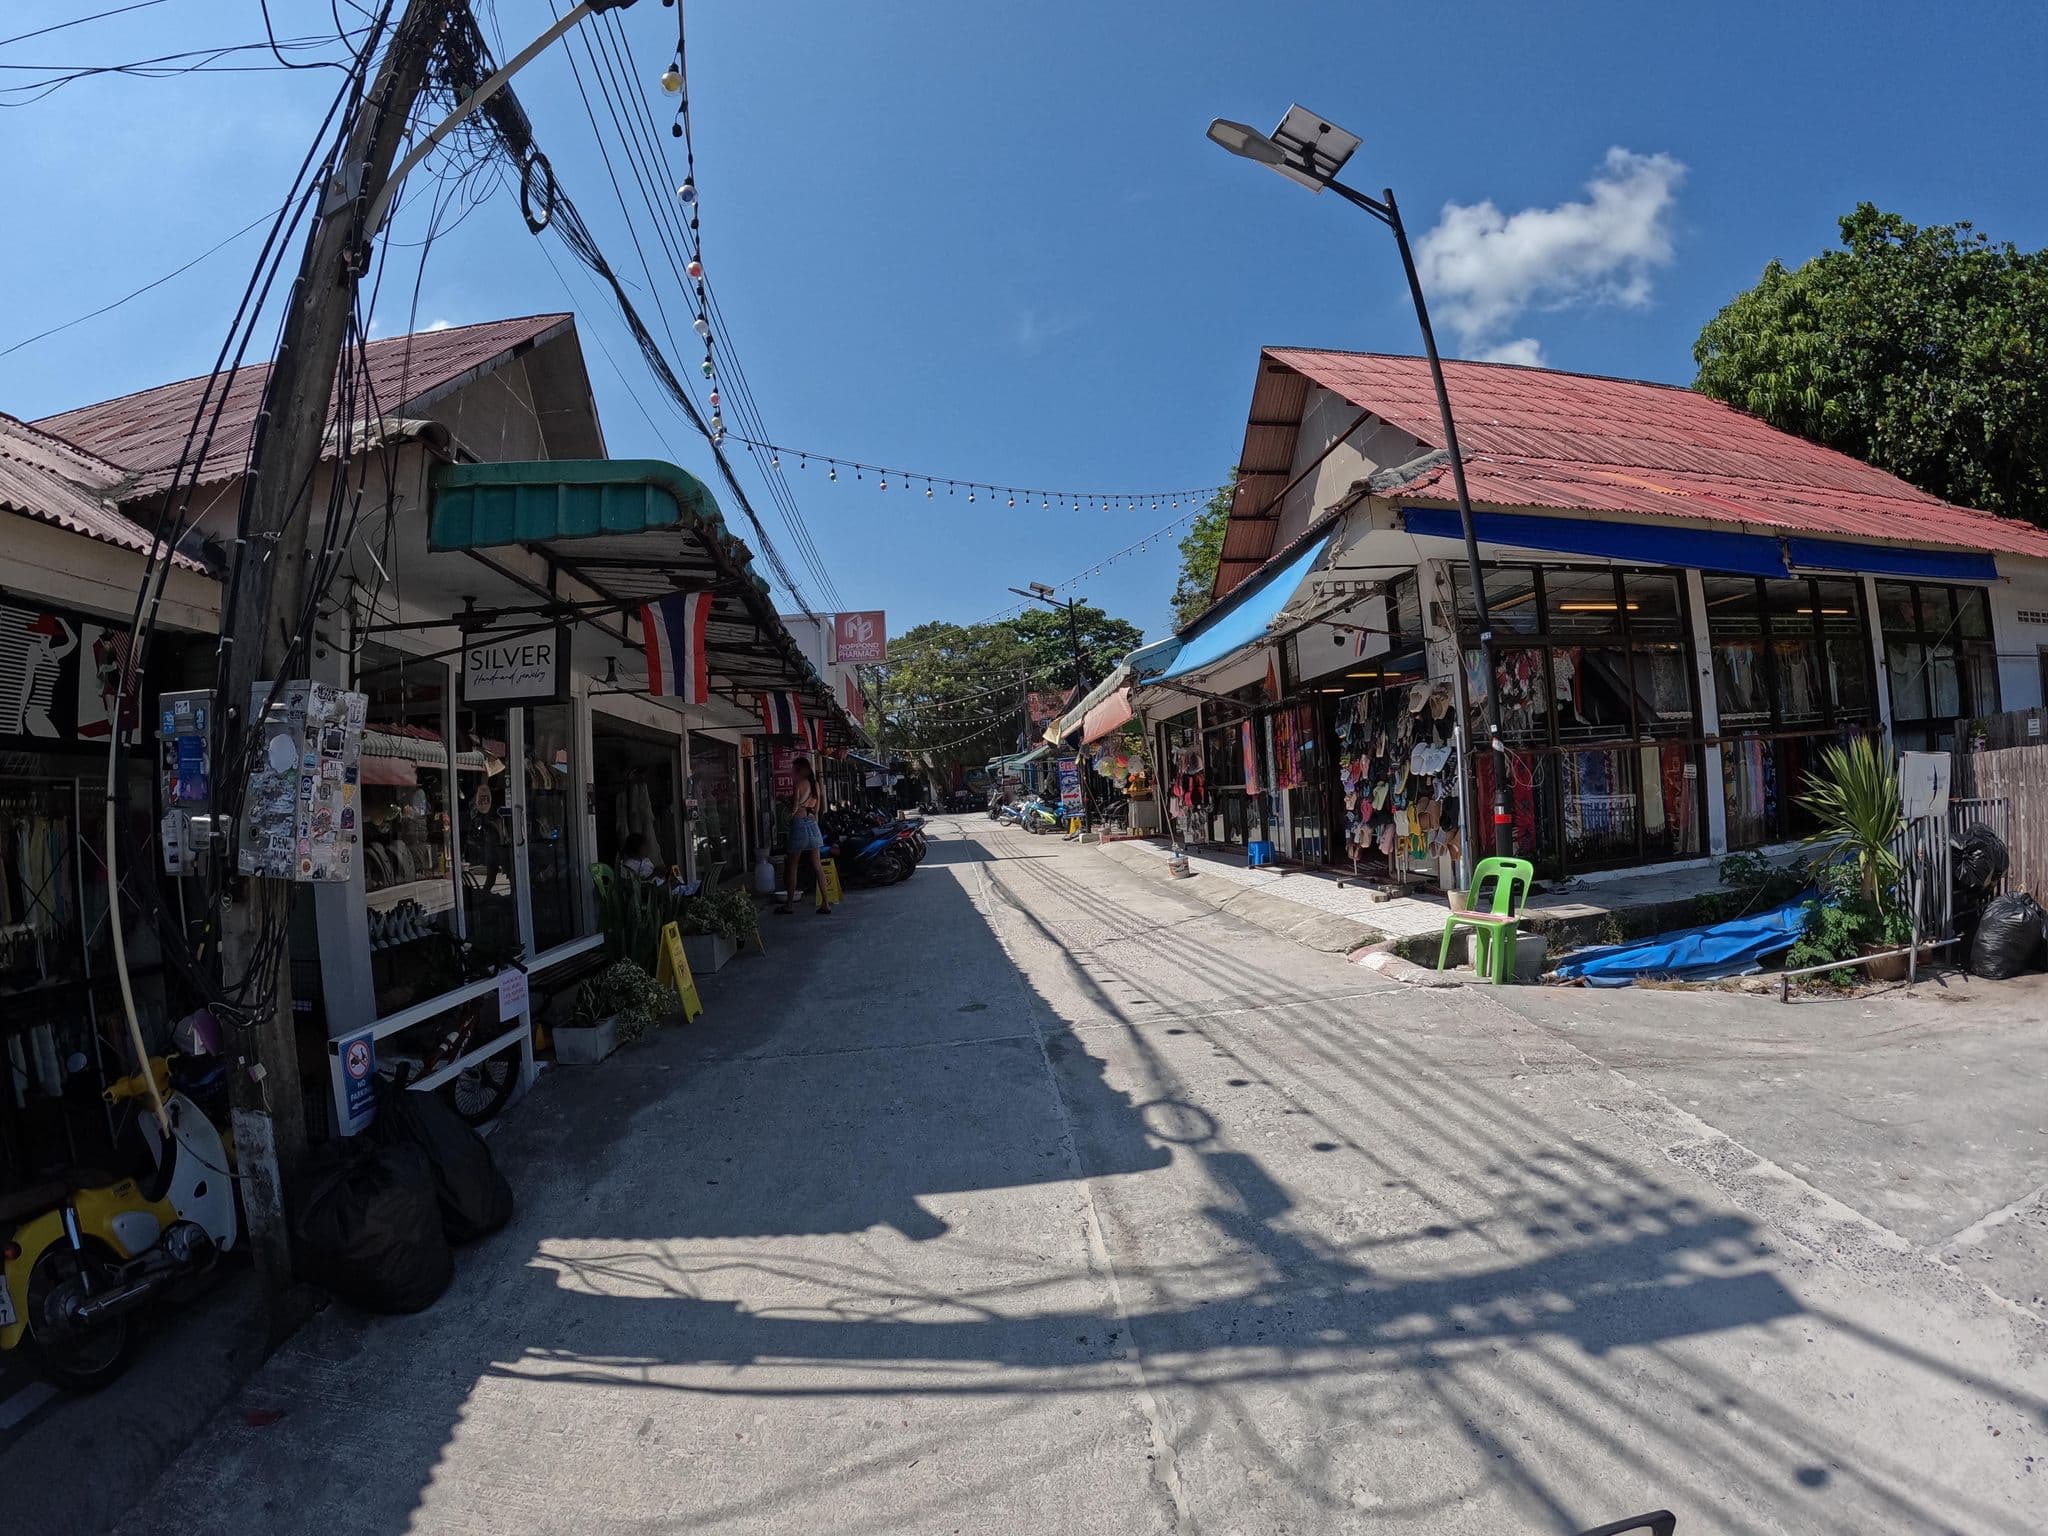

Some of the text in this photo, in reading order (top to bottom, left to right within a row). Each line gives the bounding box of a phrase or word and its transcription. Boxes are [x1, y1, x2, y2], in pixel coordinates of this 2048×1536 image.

[470, 644, 551, 670] SILVER
[838, 649, 880, 658] PHARMACY
[357, 1079, 367, 1089] NO
